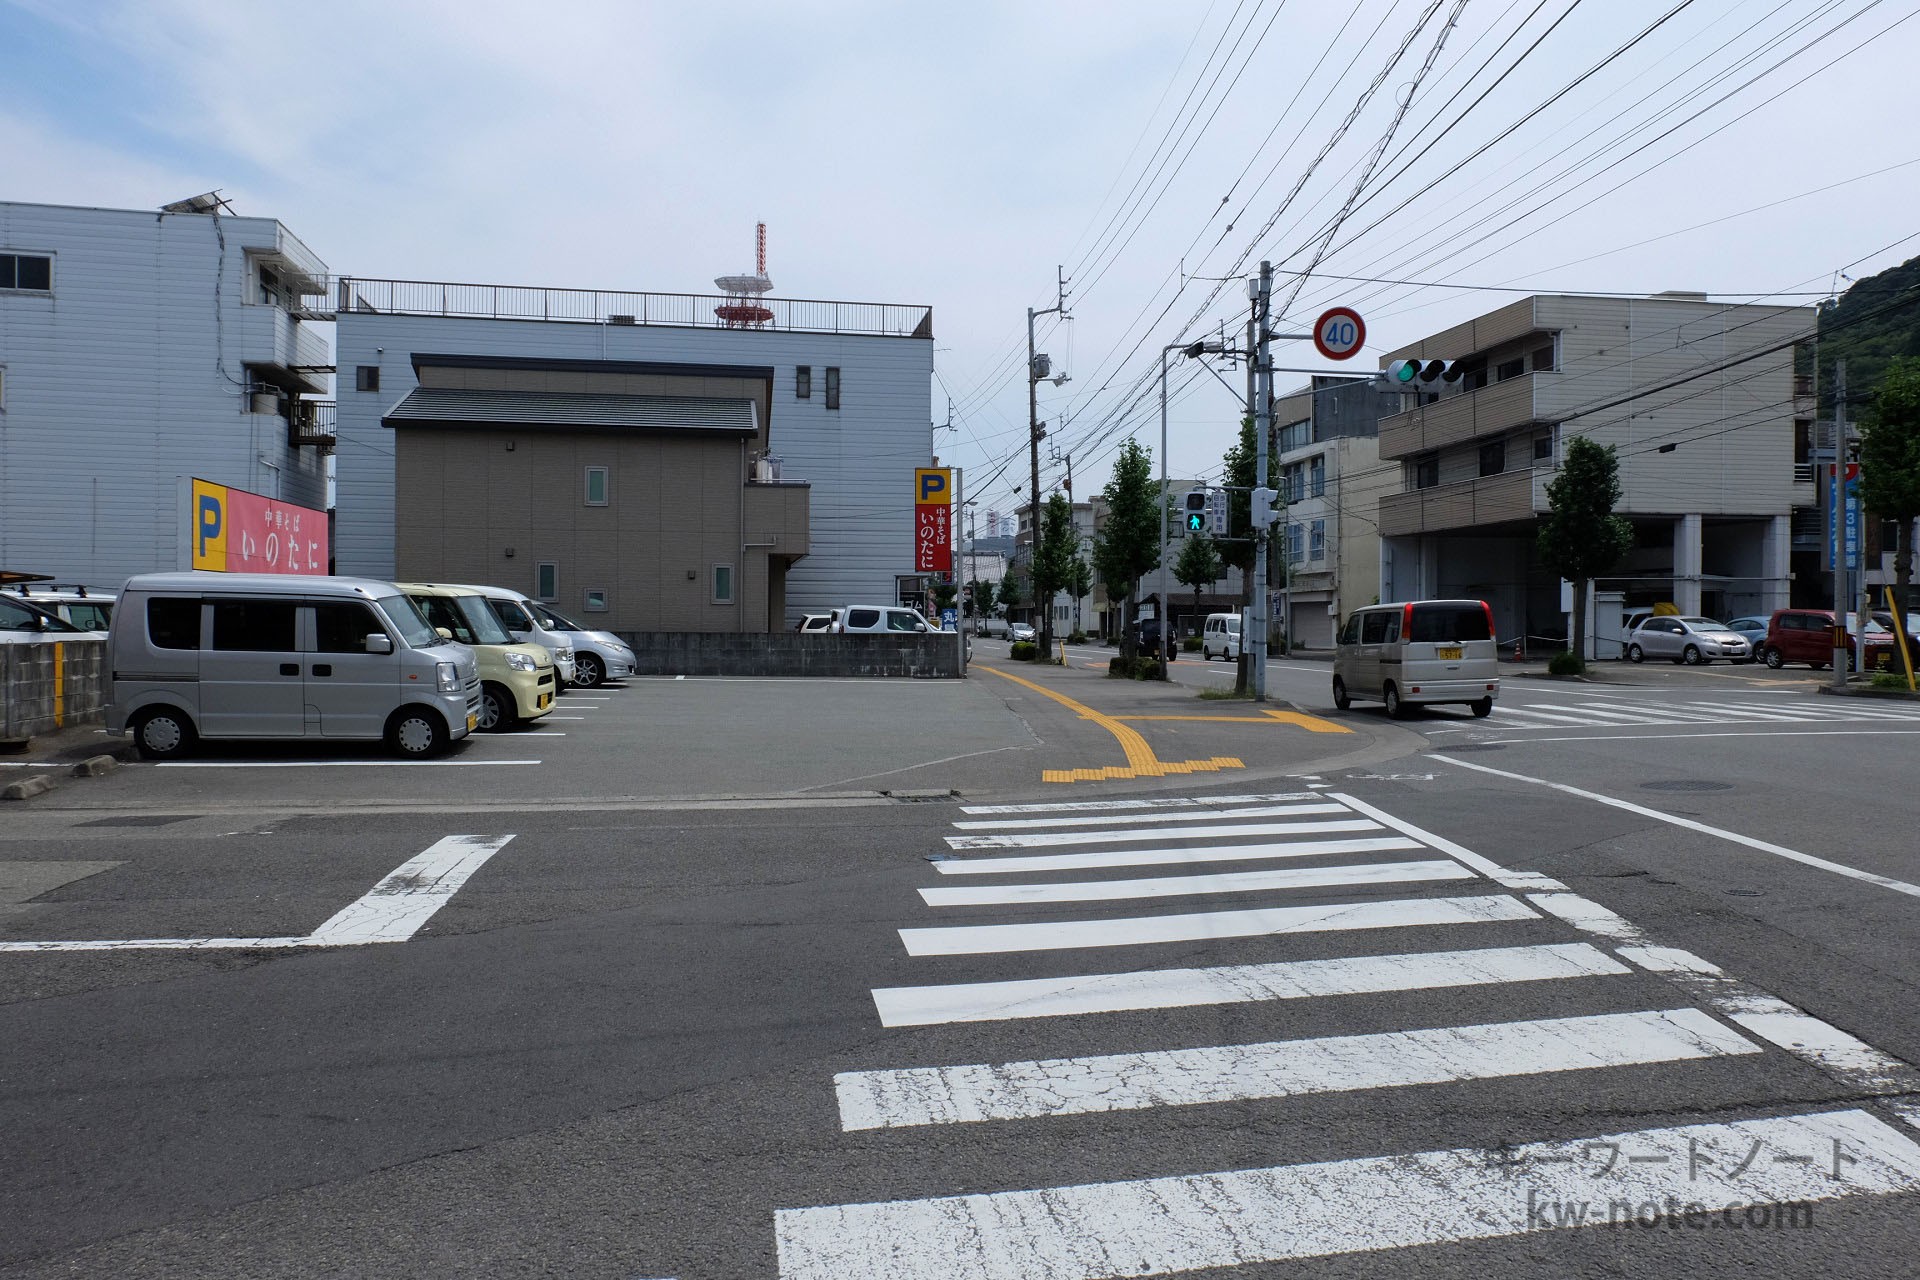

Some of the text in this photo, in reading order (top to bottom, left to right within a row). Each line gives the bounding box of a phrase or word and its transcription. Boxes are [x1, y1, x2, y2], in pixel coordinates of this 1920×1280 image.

[1325, 322, 1354, 345] 40
[921, 474, 945, 500] P
[199, 494, 221, 557] P
[264, 507, 300, 532] 中華そば
[936, 507, 946, 545] 中華そば
[242, 529, 319, 571] いのたに
[920, 512, 934, 568] いのたに
